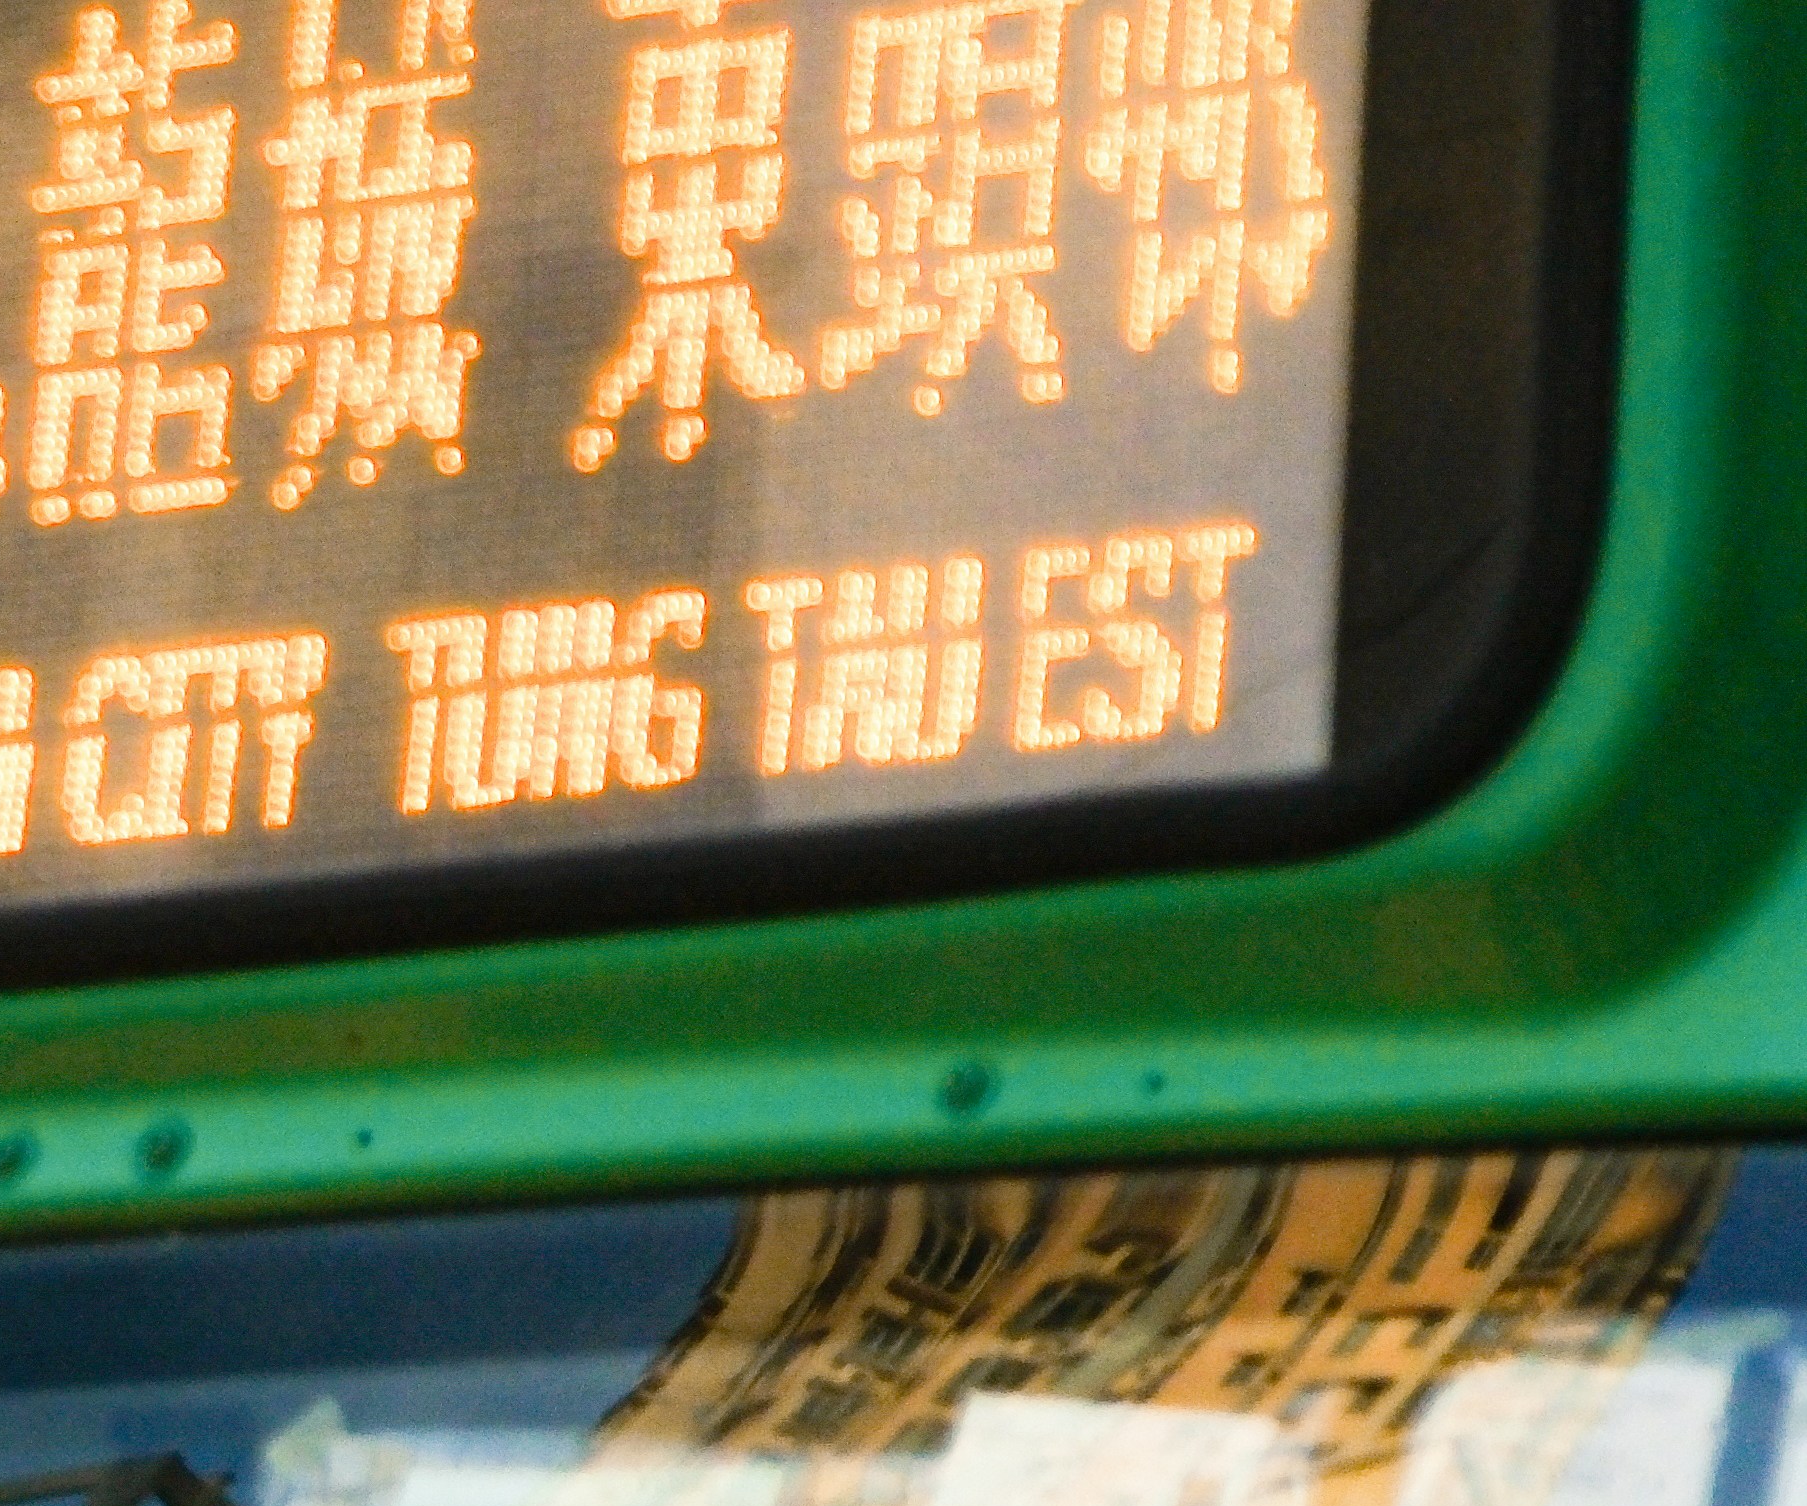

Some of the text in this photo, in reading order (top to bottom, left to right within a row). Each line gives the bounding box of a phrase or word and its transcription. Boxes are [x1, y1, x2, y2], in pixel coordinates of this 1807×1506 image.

[63, 633, 329, 846] CITY
[386, 590, 706, 815] TUNG
[1014, 525, 1258, 751] EST
